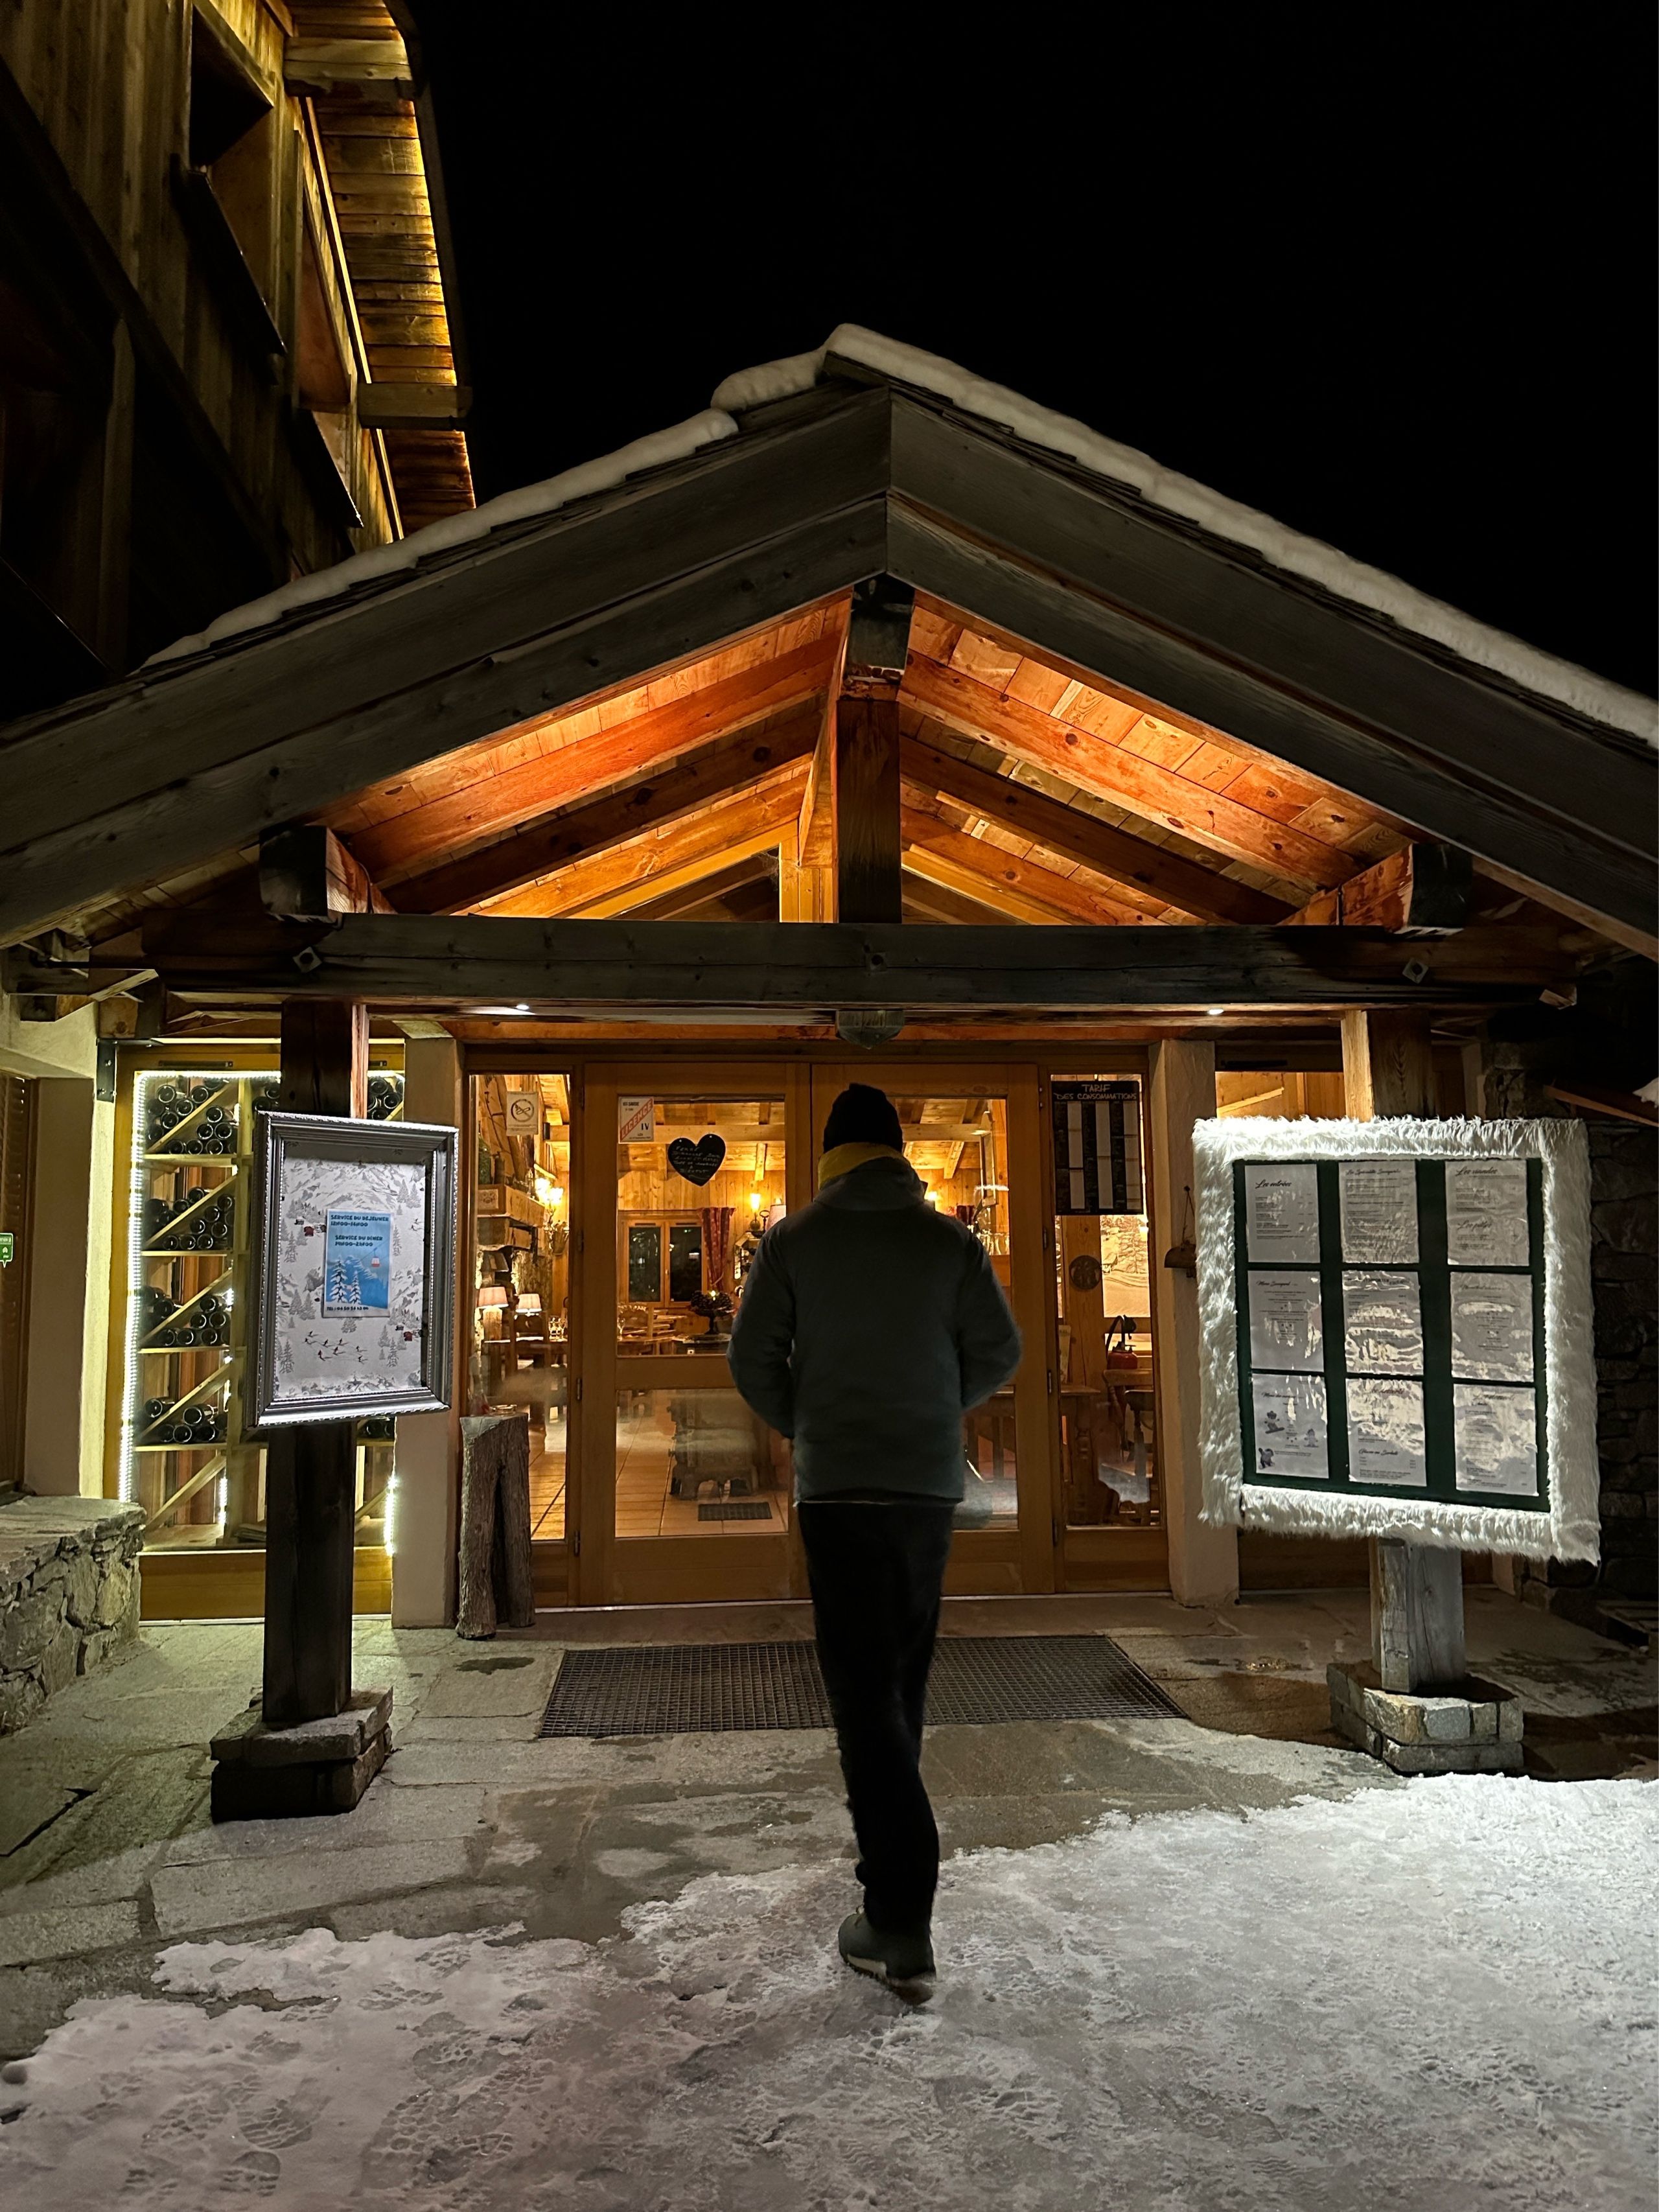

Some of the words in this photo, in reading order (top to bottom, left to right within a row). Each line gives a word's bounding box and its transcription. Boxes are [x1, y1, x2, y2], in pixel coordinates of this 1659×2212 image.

[1081, 1084, 1111, 1093] TARIF
[621, 1099, 653, 1139] LICENCE
[641, 1123, 649, 1131] IV
[1456, 1167, 1472, 1177] Les
